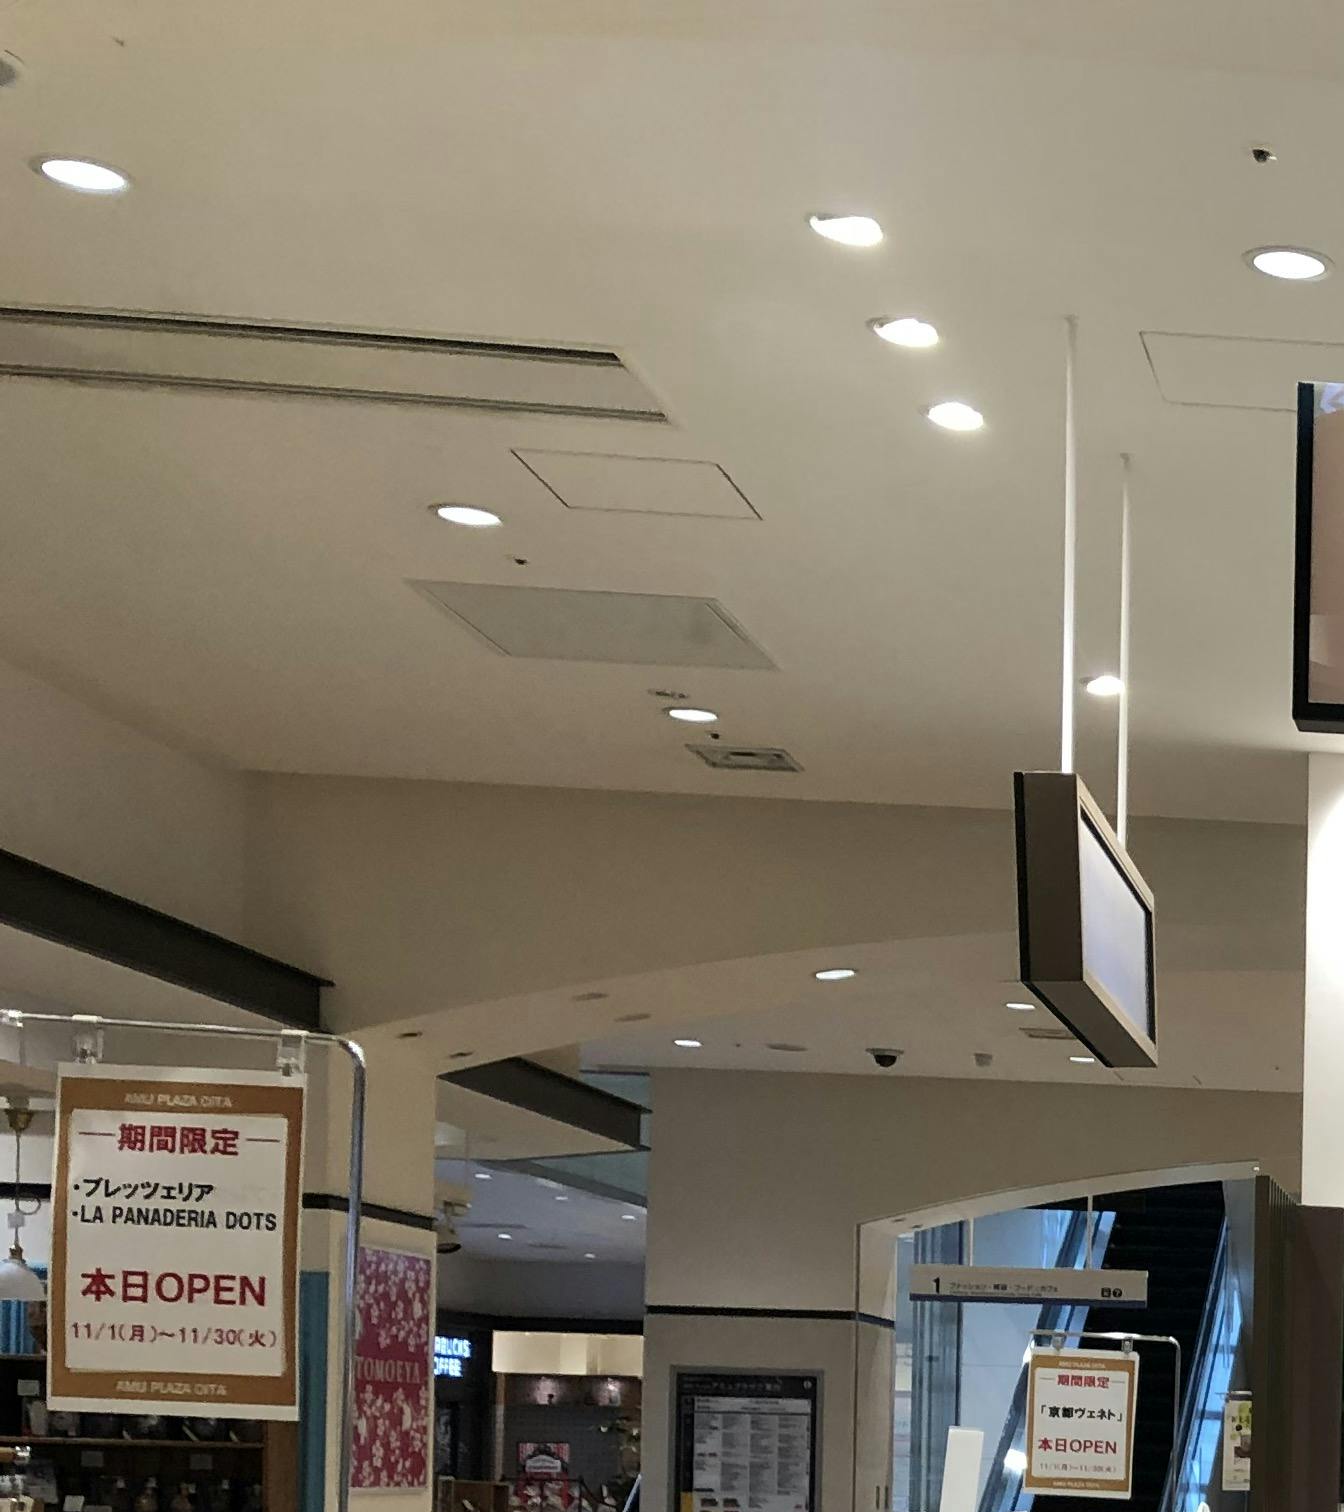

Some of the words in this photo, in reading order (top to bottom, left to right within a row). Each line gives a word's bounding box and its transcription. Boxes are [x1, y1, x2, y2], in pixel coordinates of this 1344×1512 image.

[118, 1123, 239, 1155] 期間限定
[112, 1206, 217, 1228] PANADERIA
[224, 1211, 277, 1232] DOTS
[81, 1267, 266, 1307] 本日OPEN
[1038, 1437, 1117, 1454] 本日OPEN
